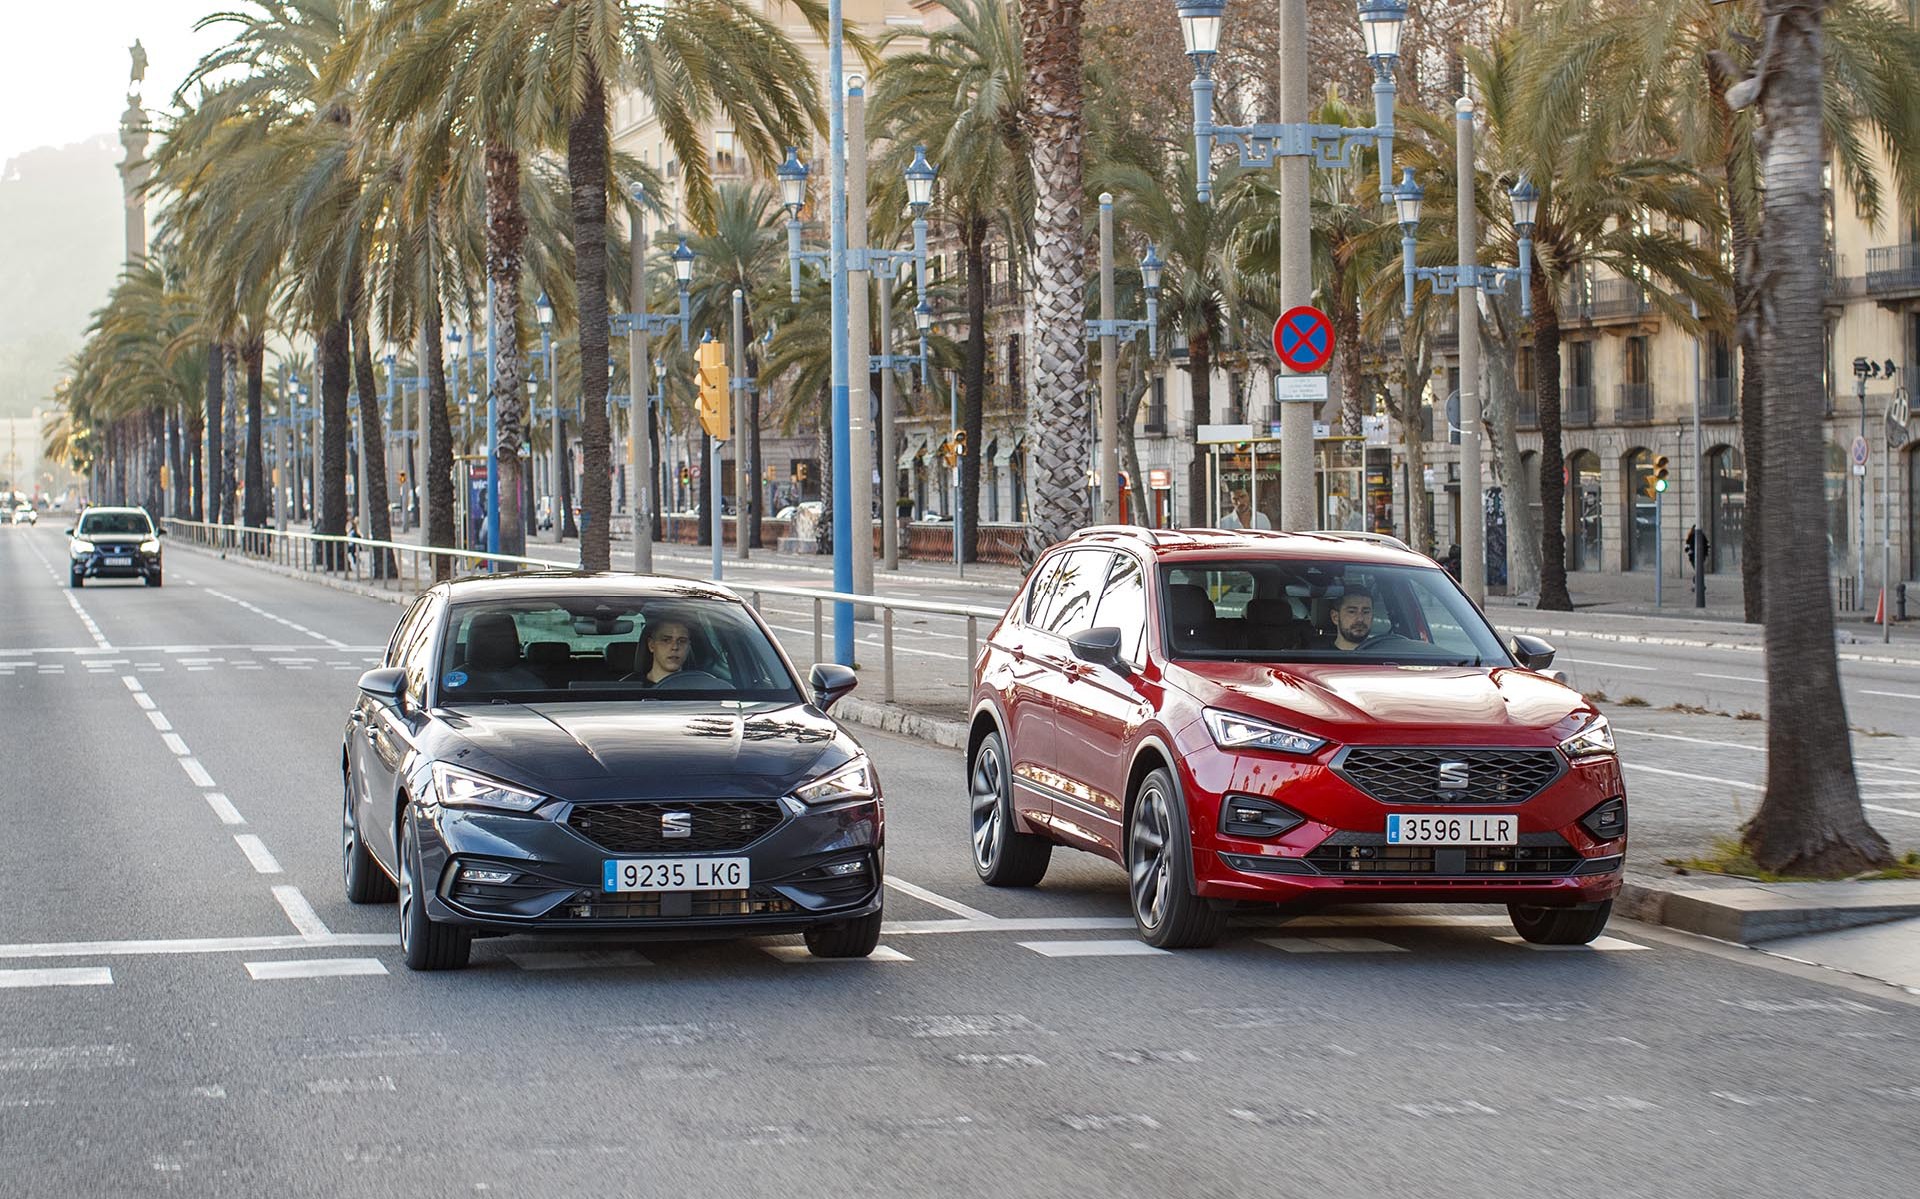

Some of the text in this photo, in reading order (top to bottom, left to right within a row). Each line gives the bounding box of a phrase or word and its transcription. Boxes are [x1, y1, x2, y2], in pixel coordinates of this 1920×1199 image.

[1391, 819, 1510, 841] E 3596 LLR
[607, 862, 741, 888] E 9235 LKG
